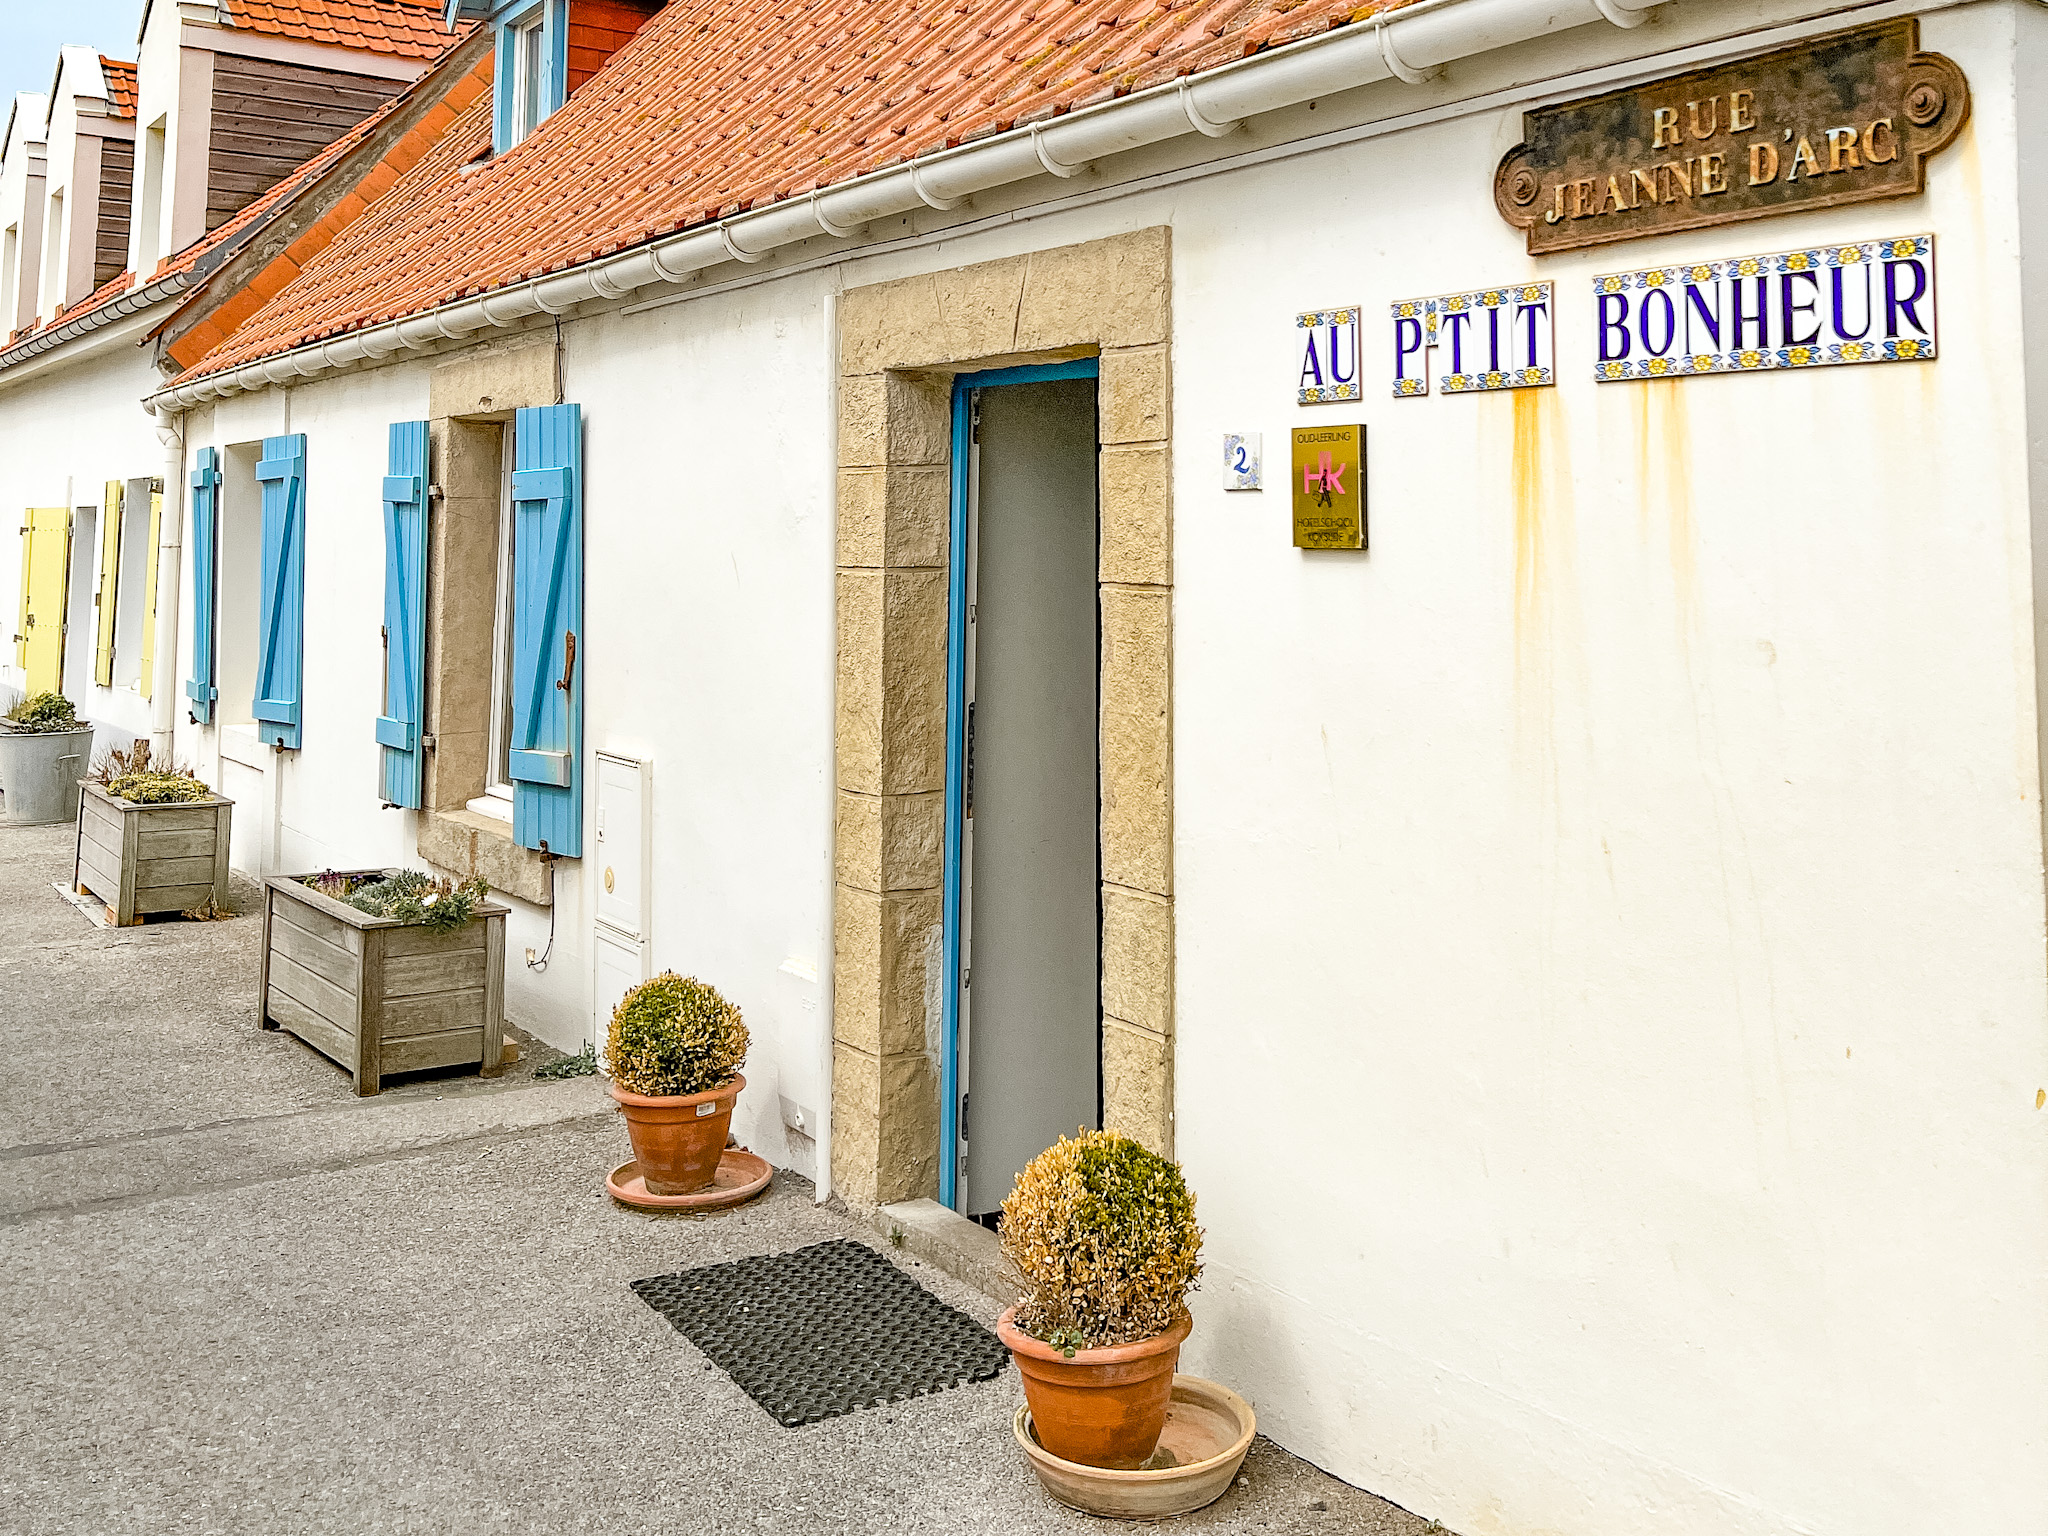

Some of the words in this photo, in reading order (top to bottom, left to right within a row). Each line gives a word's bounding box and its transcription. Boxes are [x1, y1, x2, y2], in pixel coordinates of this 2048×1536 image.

[1652, 88, 1756, 150] RUE
[1544, 150, 1728, 224] JEANNE
[1746, 117, 1898, 187] D'ARC
[1299, 323, 1356, 387] AU
[1598, 257, 1930, 362] BONHEUR
[1233, 446, 1251, 474] 2
